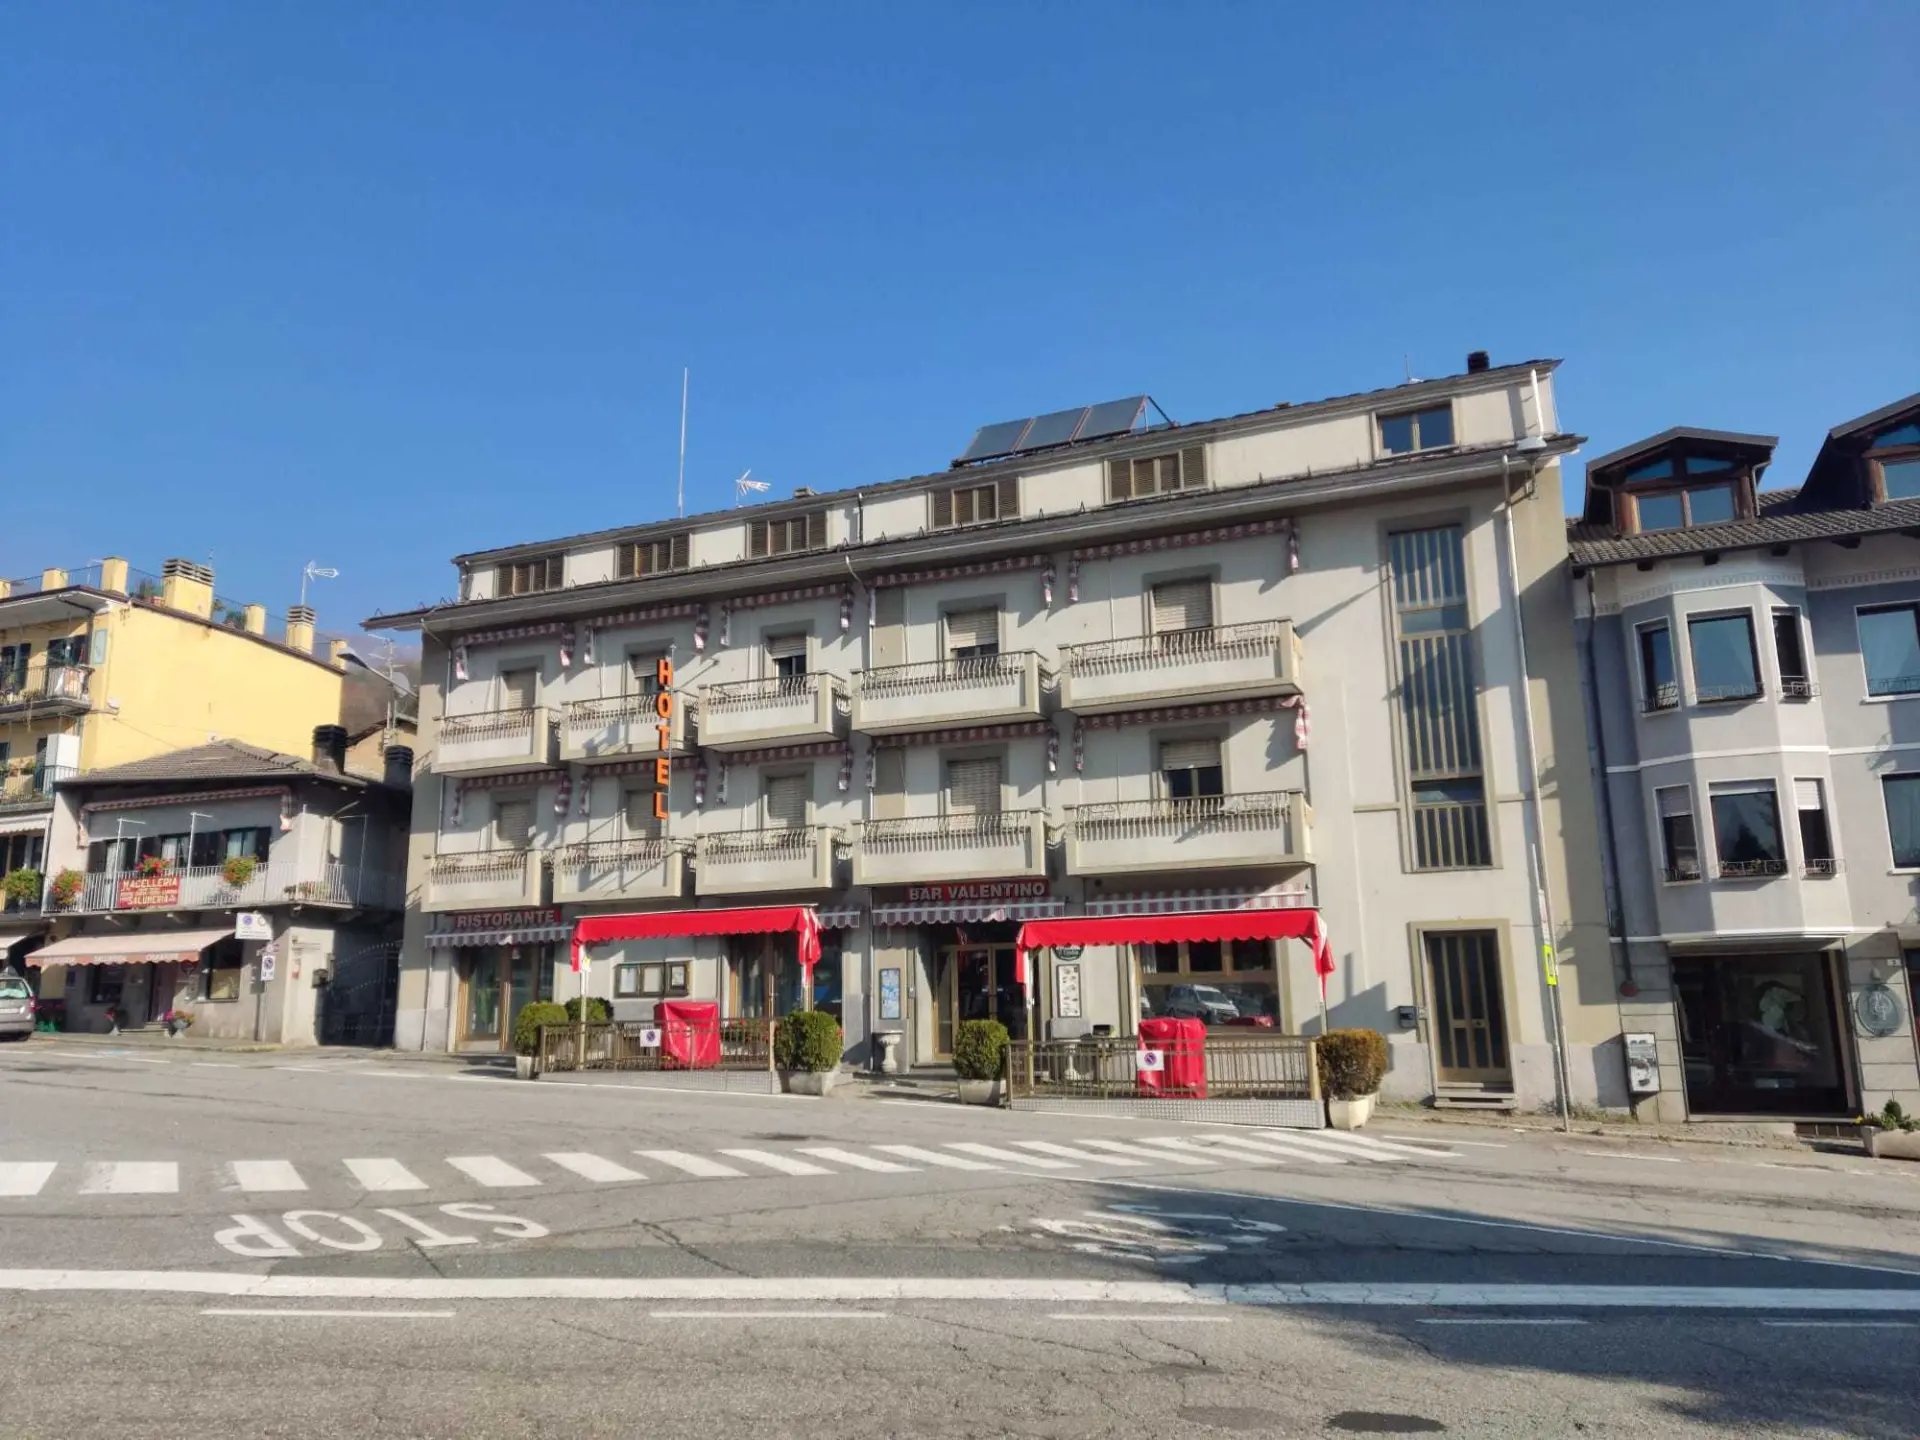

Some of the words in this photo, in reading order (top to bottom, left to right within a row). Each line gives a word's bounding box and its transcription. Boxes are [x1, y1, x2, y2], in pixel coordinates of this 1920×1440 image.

[655, 657, 673, 819] HOTEL
[122, 877, 178, 891] MACELLERIA
[909, 886, 942, 901] BAR
[948, 882, 1045, 899] VALENTINO
[456, 909, 555, 928] RISTORANTE
[213, 1201, 550, 1258] STOP
